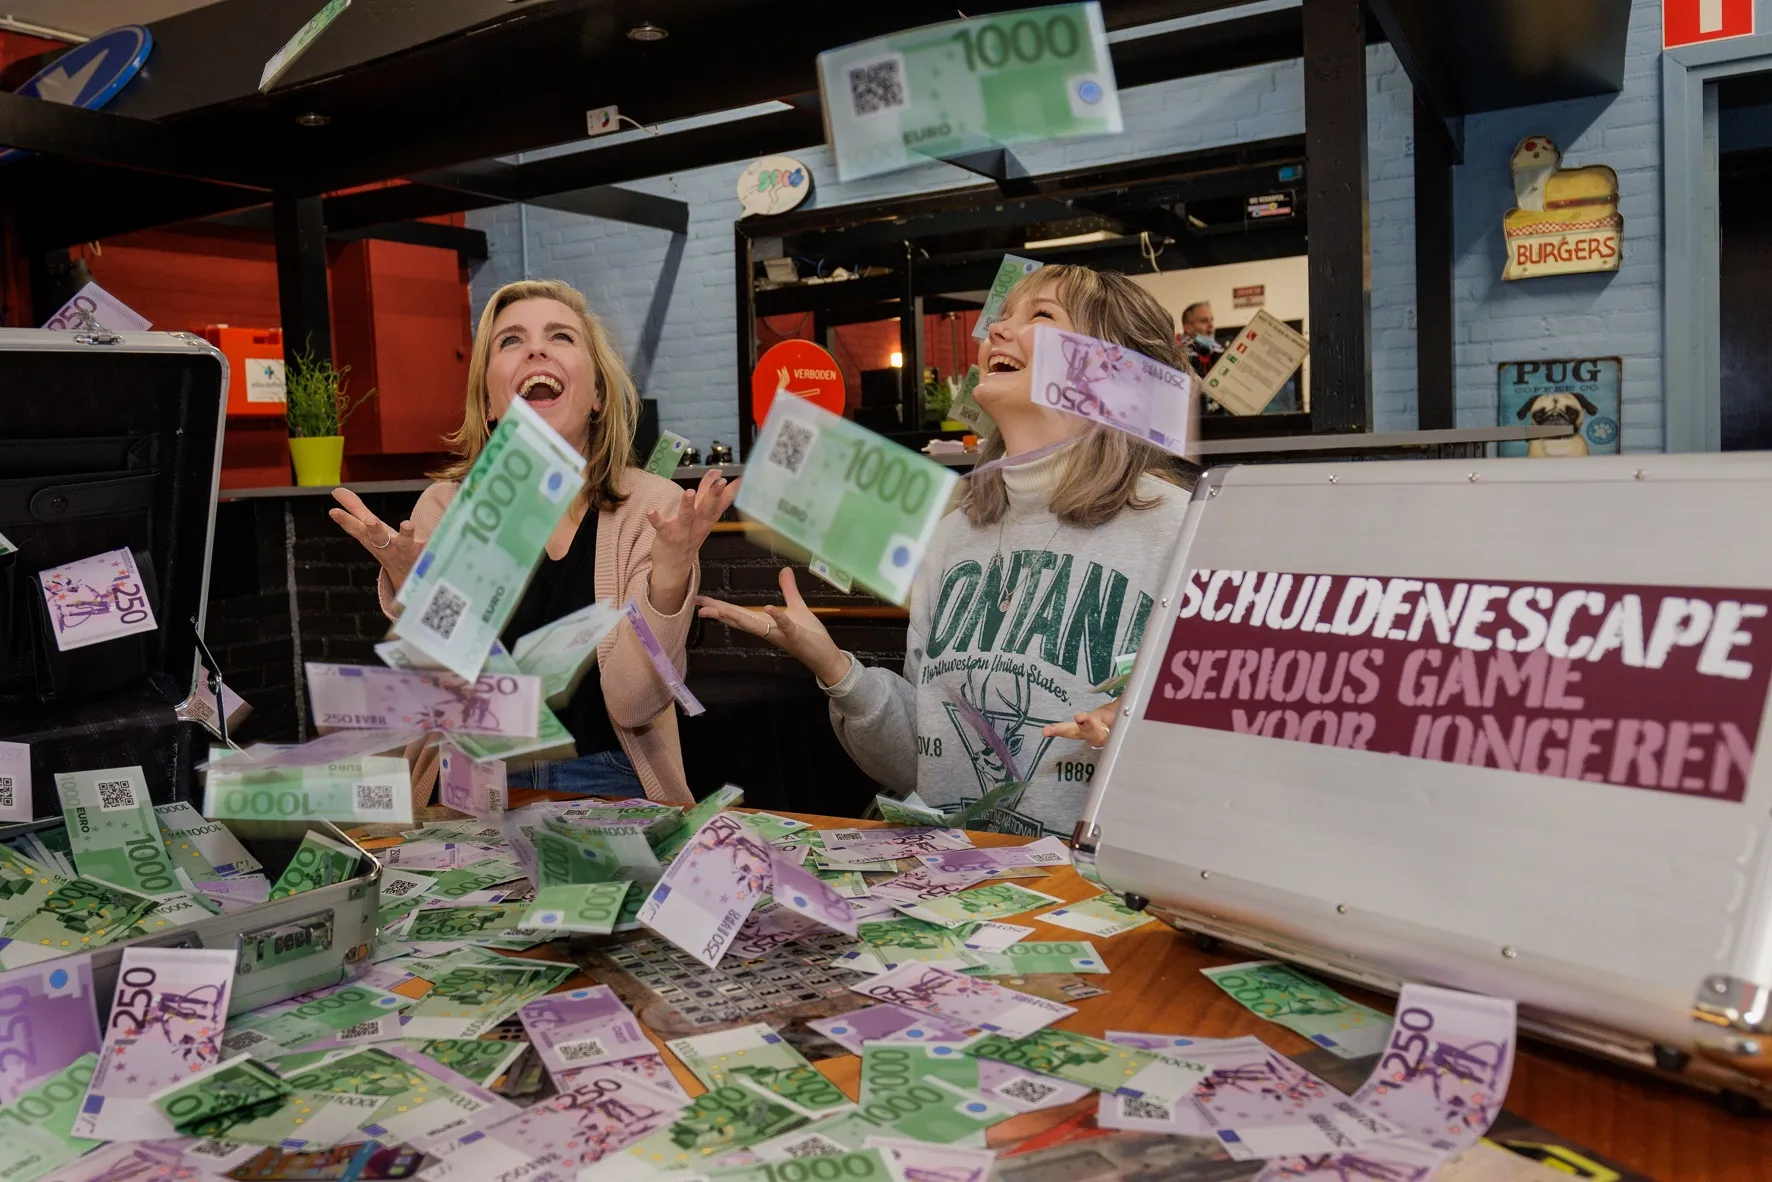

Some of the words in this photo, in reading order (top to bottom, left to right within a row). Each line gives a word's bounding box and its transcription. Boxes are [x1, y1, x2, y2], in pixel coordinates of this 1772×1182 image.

[951, 14, 1081, 73] 1000
[903, 122, 951, 146] EURO
[1516, 236, 1617, 266] BURGERS
[794, 369, 837, 381] VERBODEN
[1512, 360, 1602, 386] PUG
[844, 439, 932, 515] 1000
[461, 448, 533, 545] 1000
[112, 583, 148, 625] 250
[482, 585, 505, 624] EURO
[1179, 568, 1768, 679] SCHULDENESCAPE
[476, 675, 518, 695] 50
[922, 655, 990, 685] Northwestern
[991, 654, 1025, 678] United
[1164, 648, 1385, 704] SERIOUS
[1398, 648, 1585, 711] GAME
[323, 713, 352, 725] 250
[1055, 761, 1095, 783] 1889
[223, 789, 315, 816] 1000
[76, 806, 90, 833] EURO
[193, 824, 222, 837] 1000
[702, 815, 741, 847] 250
[892, 833, 936, 846] 250
[125, 831, 174, 891] 1000
[270, 846, 317, 901] 000
[46, 880, 99, 910] 000
[444, 874, 507, 896] 1000
[579, 880, 623, 921] 000
[702, 934, 726, 961] 250
[718, 909, 736, 933] EURO
[432, 968, 479, 994] 000
[113, 967, 156, 1030] 250
[283, 990, 367, 1020] 1000
[973, 1037, 1053, 1070] 000
[1382, 1007, 1435, 1078] 250
[785, 1068, 845, 1105] 000
[869, 1049, 910, 1096] 1000
[554, 1078, 623, 1108] 250
[849, 1085, 945, 1128] 1000
[758, 1154, 875, 1182] 1000
